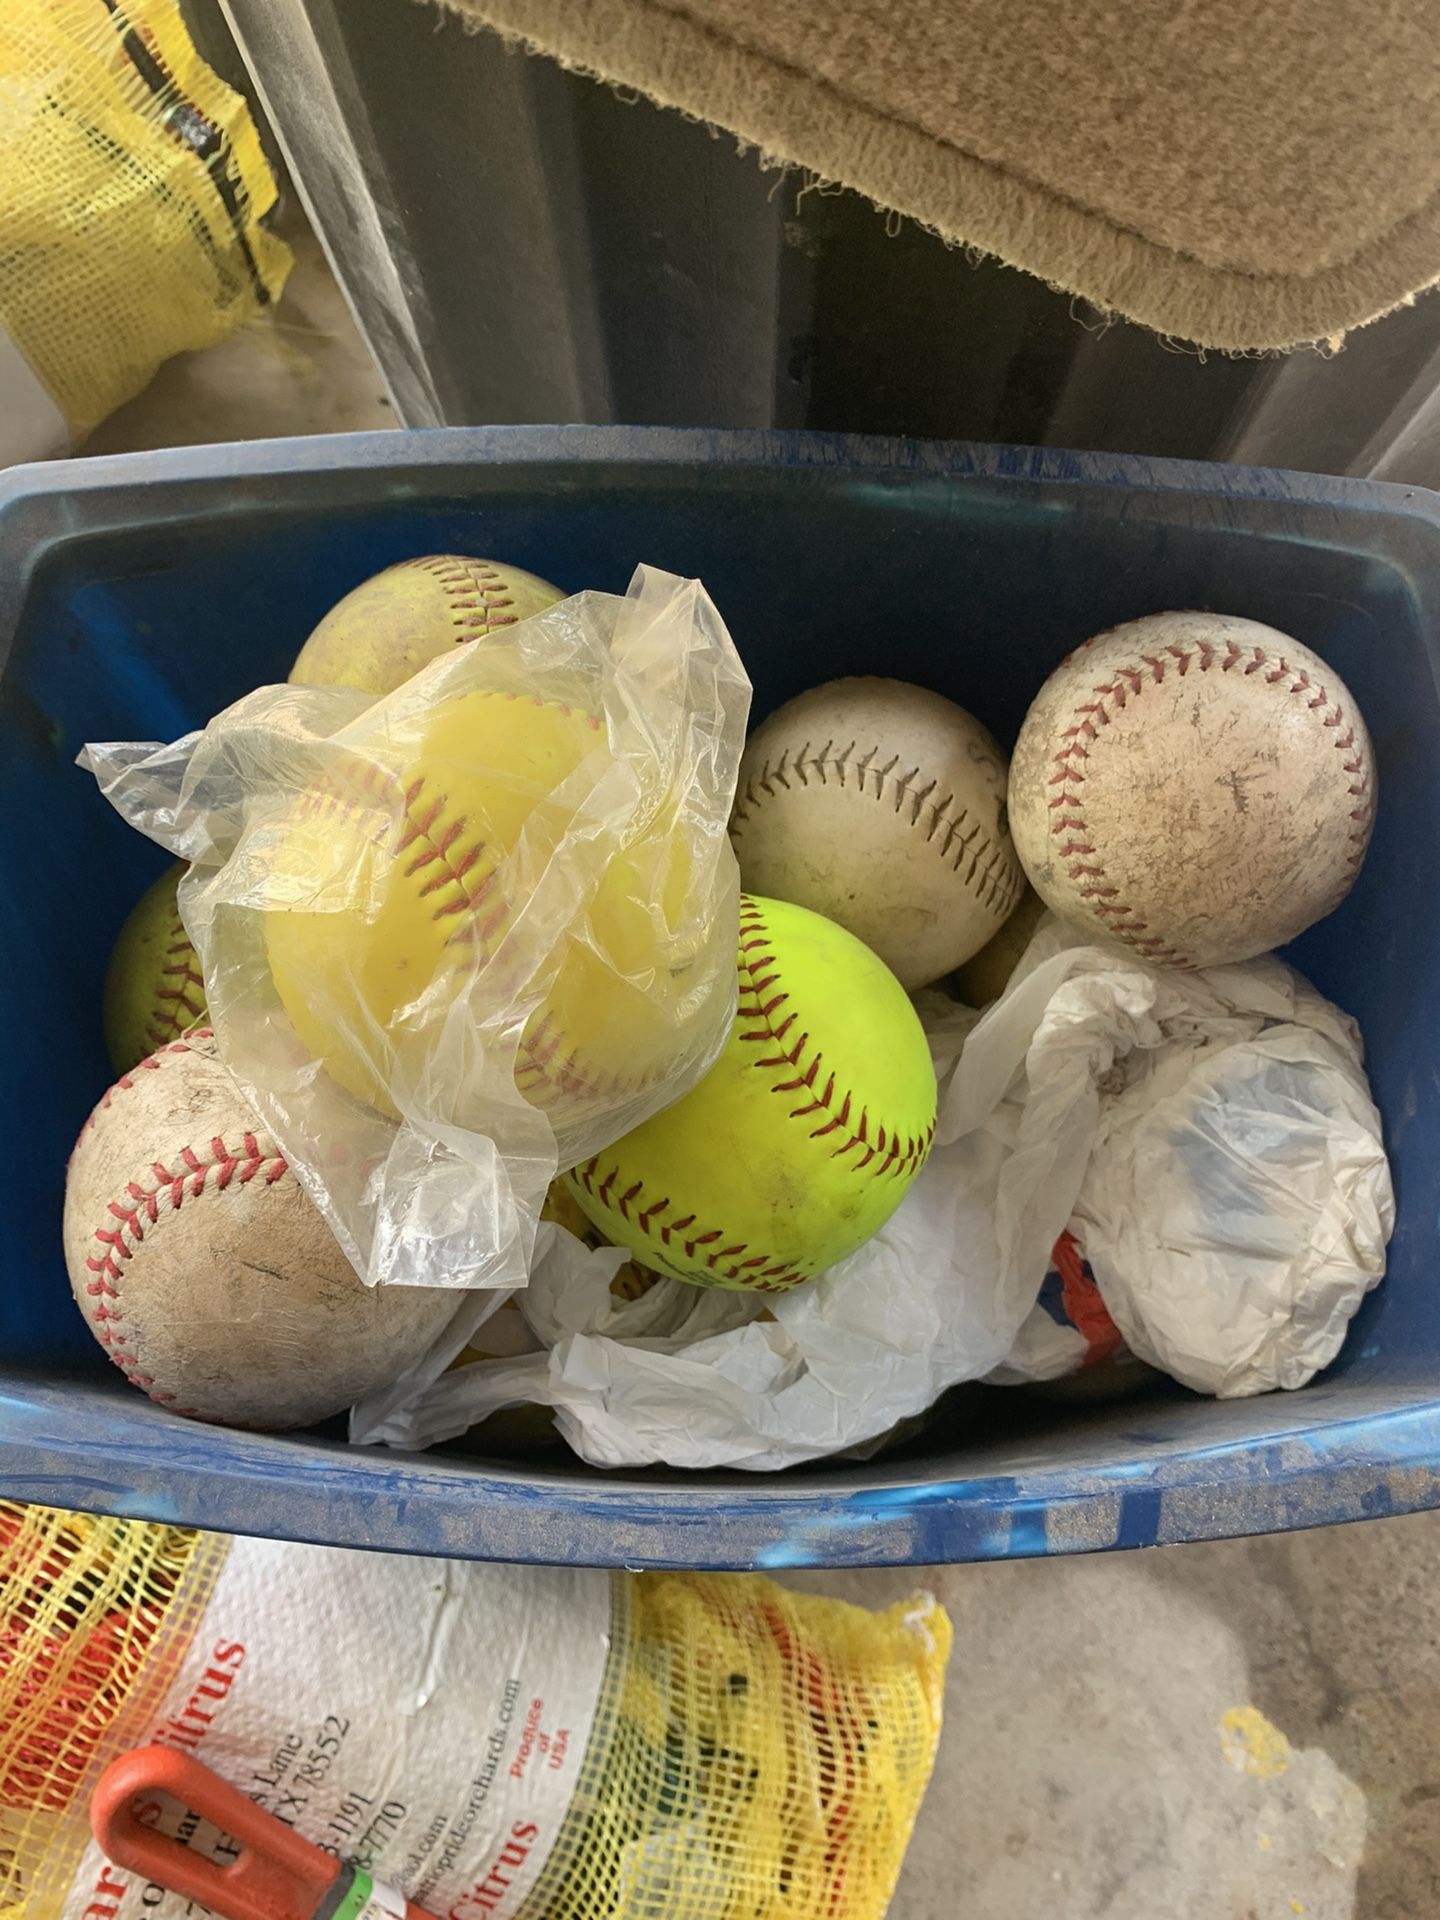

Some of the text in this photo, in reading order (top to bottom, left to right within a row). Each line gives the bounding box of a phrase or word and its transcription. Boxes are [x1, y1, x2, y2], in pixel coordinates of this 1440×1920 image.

[151, 1638, 246, 1748] itrus
[253, 1735, 303, 1787] Lane
[272, 1716, 350, 1826] TX 78552
[509, 1699, 544, 1778] Produce
[538, 1732, 550, 1753] of
[547, 1729, 572, 1770] USA
